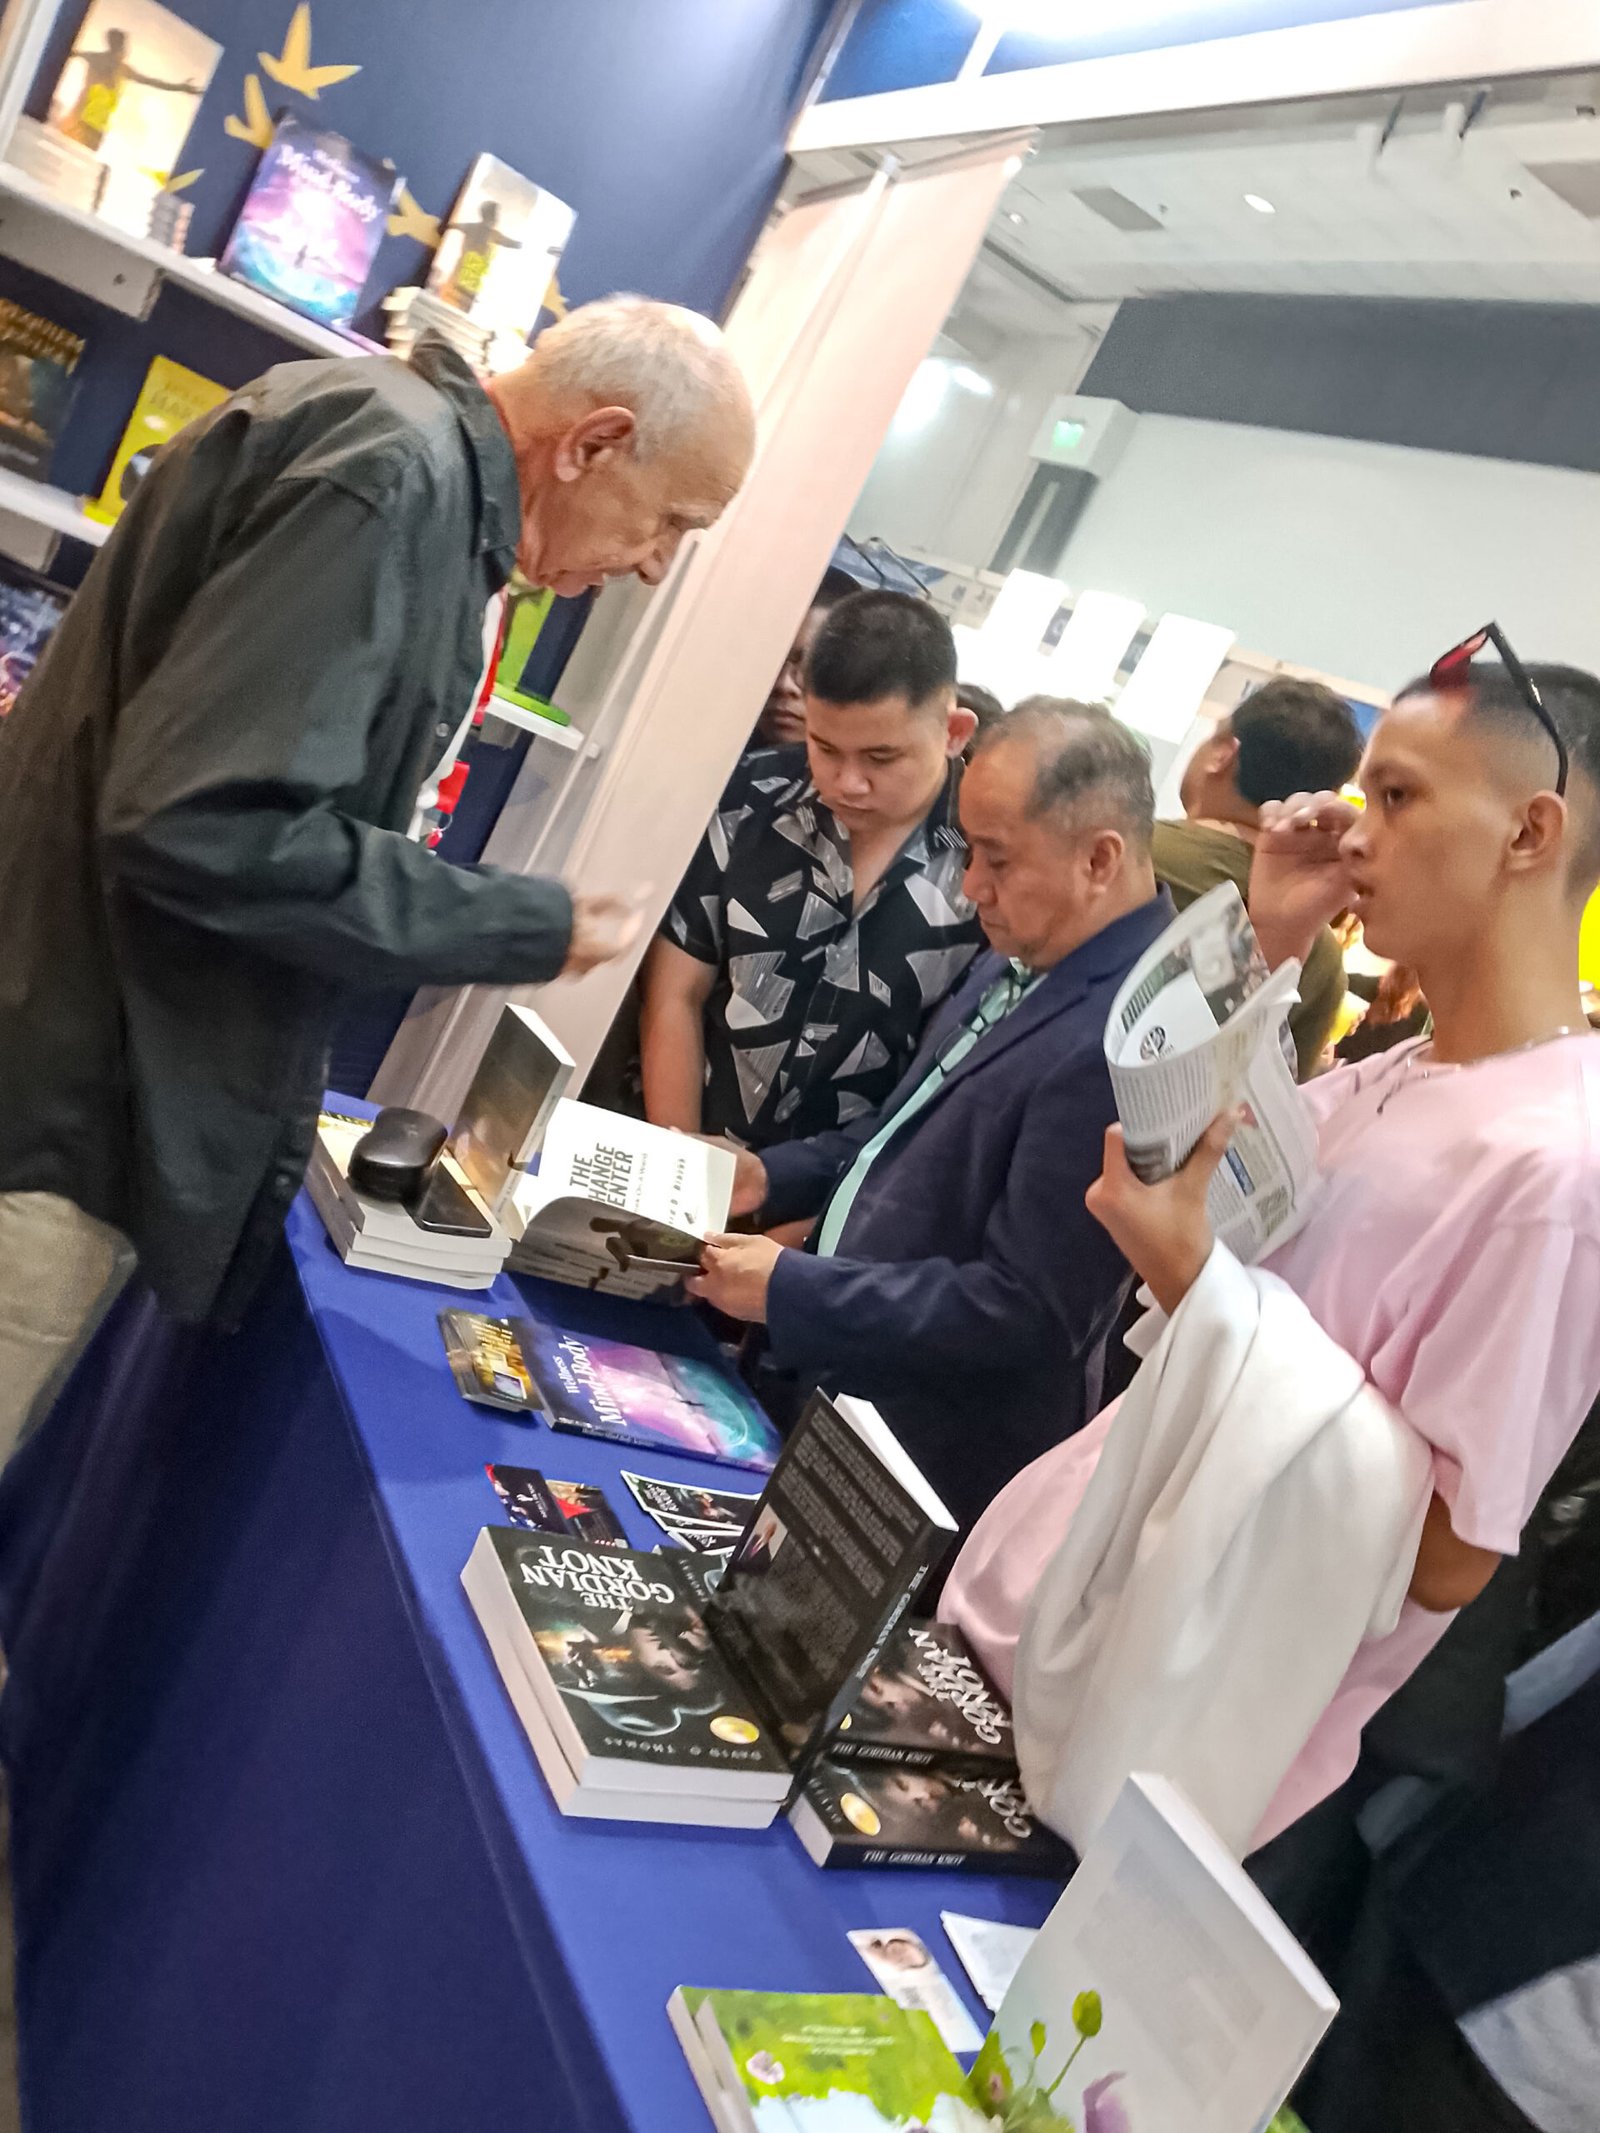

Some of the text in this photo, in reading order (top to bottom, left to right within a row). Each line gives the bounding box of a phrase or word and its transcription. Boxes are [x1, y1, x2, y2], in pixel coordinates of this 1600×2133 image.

[569, 1153, 593, 1188] THE
[588, 1142, 615, 1203] HANGE
[607, 1150, 634, 1207] ENTER
[552, 1355, 580, 1394] Wellness
[538, 1545, 644, 1583] KNOT
[908, 1563, 930, 1592] THE
[519, 1562, 675, 1604] GORDIAN
[580, 1592, 634, 1612] THE
[831, 1742, 857, 1755] THE
[856, 1745, 906, 1761] GORDIAN
[862, 1849, 889, 1863] THE
[888, 1851, 938, 1865] GORDIAN
